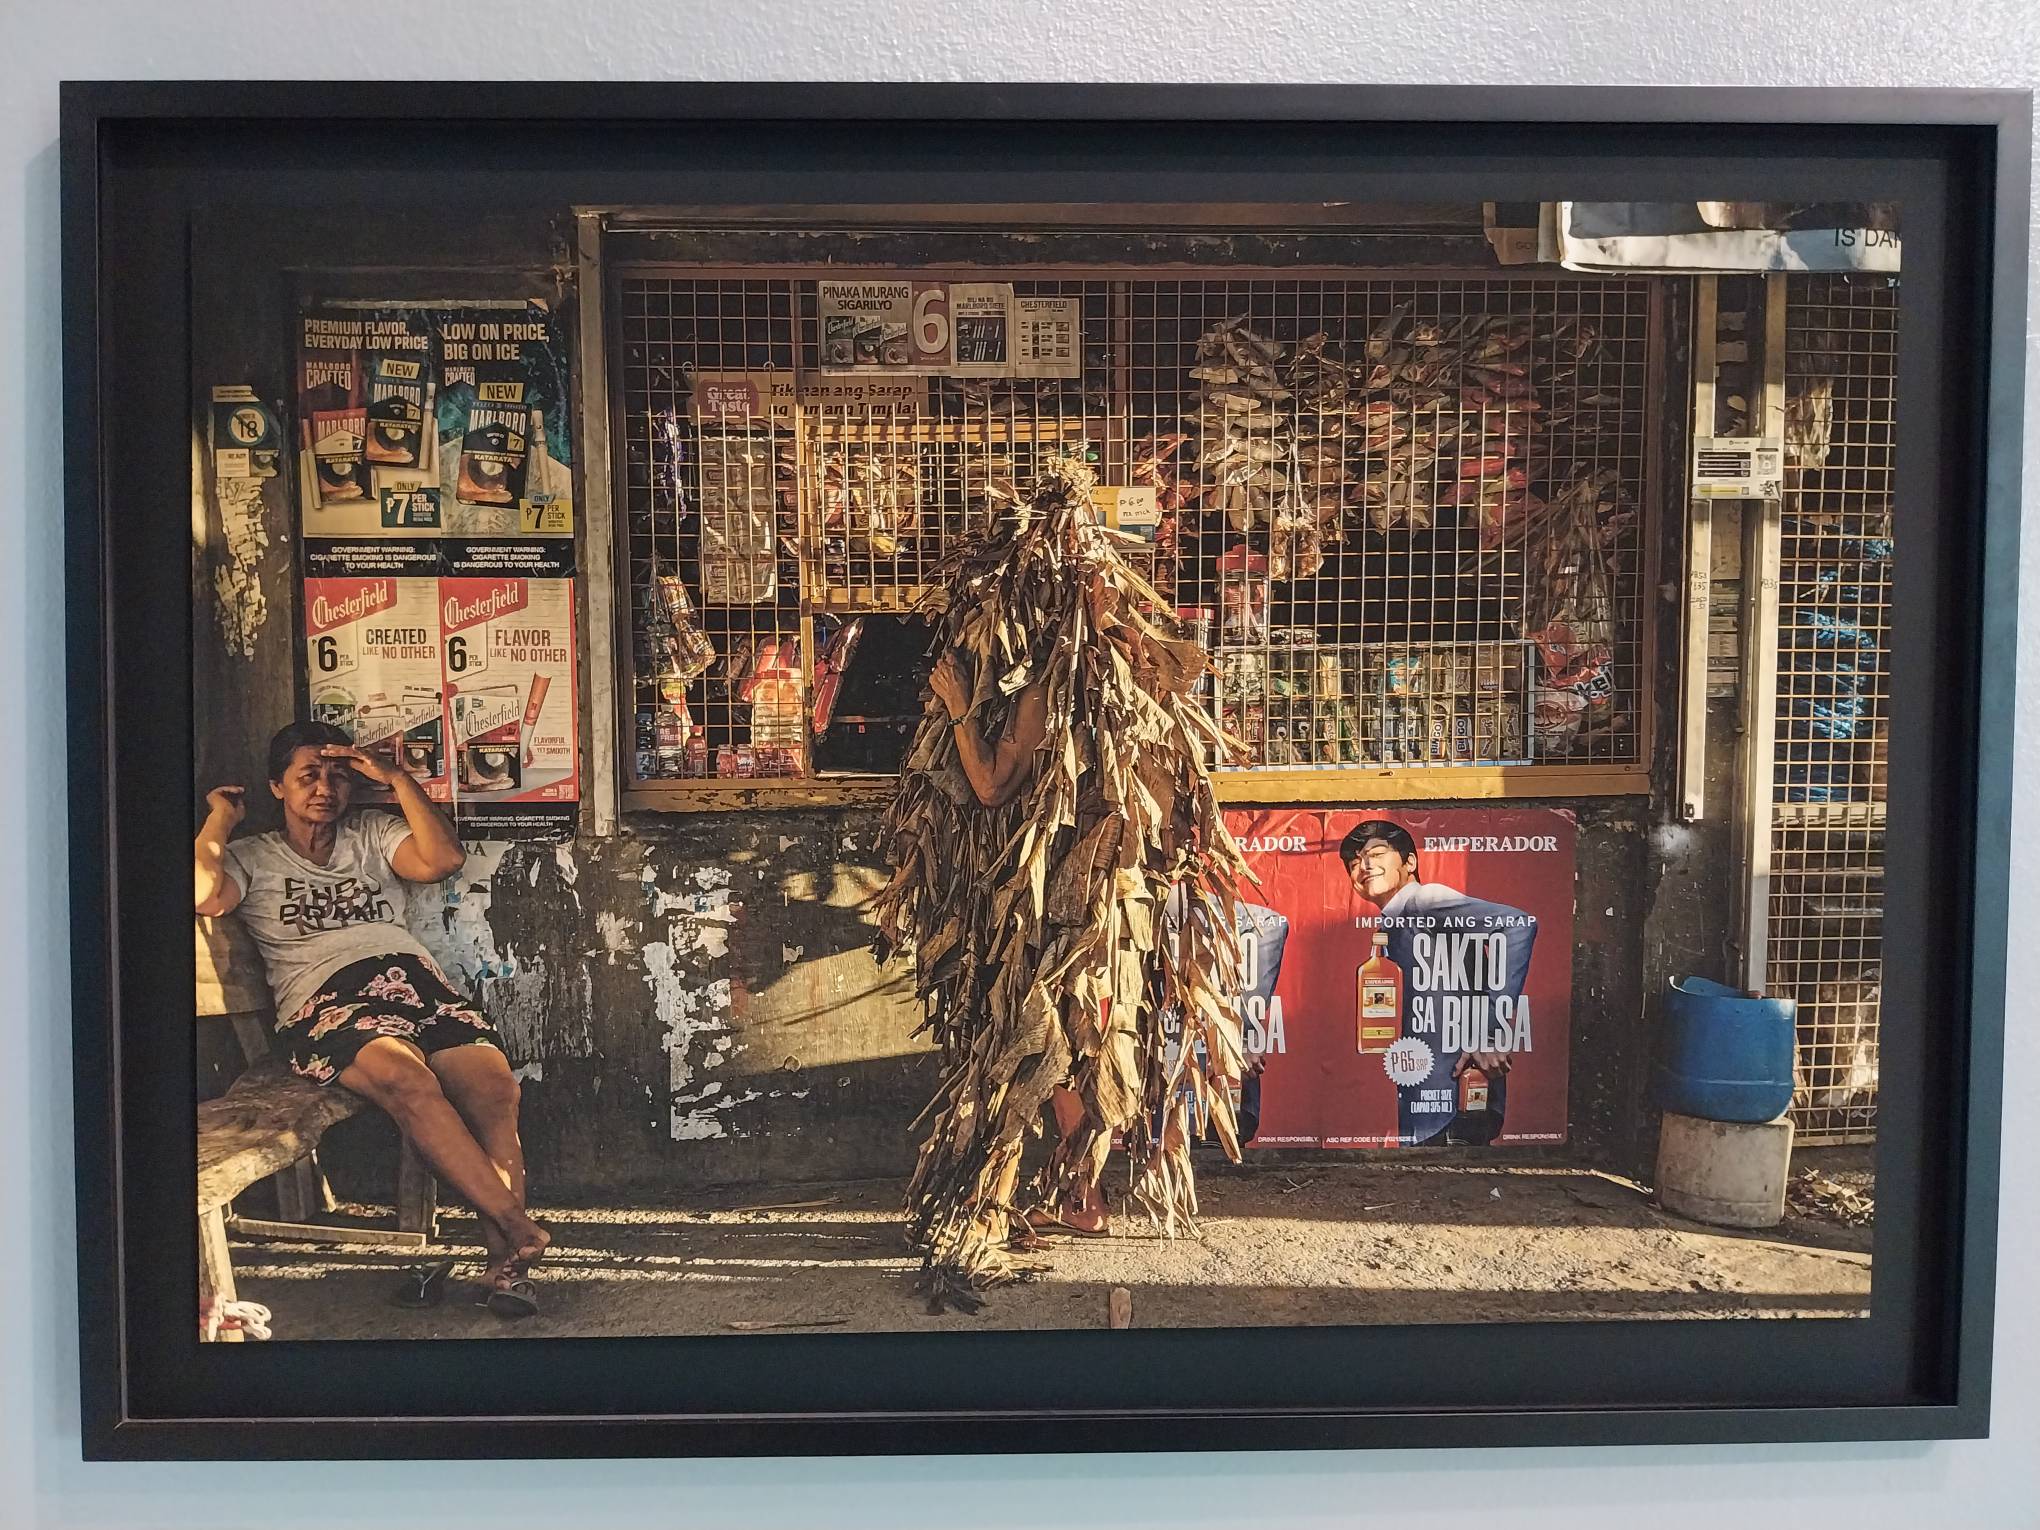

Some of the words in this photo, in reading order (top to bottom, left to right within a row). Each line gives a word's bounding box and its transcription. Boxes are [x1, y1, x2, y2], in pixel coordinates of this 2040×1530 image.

[1834, 227, 1856, 247] IS
[823, 286, 860, 298] PINAKA
[862, 286, 908, 298] MURANG
[837, 300, 893, 310] SIGARILYO
[305, 320, 362, 335] PREMIUM
[364, 321, 410, 336] FLAVOR,
[443, 323, 476, 340] LOW
[479, 323, 500, 340] ON
[503, 323, 549, 342] PRICE,
[305, 334, 363, 350] EVERYDAY
[366, 336, 392, 350] LOW
[394, 336, 429, 350] PRICE
[444, 343, 468, 360] BIG
[471, 343, 492, 360] ON
[496, 343, 520, 360] ICE
[306, 361, 351, 370] MARLBORO
[386, 363, 414, 377] NEW
[306, 369, 352, 391] CRAFTED
[444, 371, 476, 387] CRAFTED
[373, 383, 421, 406] MARLBORO
[486, 385, 517, 400] NEW
[706, 387, 750, 400] Great
[833, 386, 864, 400] ang
[868, 384, 913, 400] Sarap
[240, 420, 259, 438] 18
[317, 417, 366, 441] MARLBORO
[468, 409, 527, 436] MARLBORO
[396, 482, 415, 491] ONLY
[411, 493, 428, 503] PER
[411, 502, 435, 512] STICK
[547, 504, 560, 512] PER
[547, 512, 566, 520] STICK
[461, 561, 503, 569] DANGEROUS
[504, 561, 514, 569] TO
[515, 561, 533, 569] YOUR
[534, 561, 560, 569] HEALTH
[312, 580, 388, 629] Chesterfield
[444, 582, 519, 629] Chesterfield
[366, 629, 427, 645] CREATED
[495, 630, 551, 647] FLAVOR
[362, 647, 379, 656] LIKE
[382, 646, 397, 659] NO
[400, 646, 436, 659] OTHER
[489, 648, 507, 658] LIKE
[510, 649, 527, 662] NO
[530, 649, 567, 662] OTHER
[357, 719, 395, 743] hesterfield
[1457, 719, 1466, 751] BIGO
[1232, 836, 1307, 852] RADOR
[1424, 836, 1558, 852] EMPERADOR
[1235, 916, 1287, 928] SARAP
[1355, 916, 1437, 928] IMPORTED
[1443, 916, 1477, 928] ANG
[1484, 915, 1537, 928] SARAP
[1412, 933, 1507, 992] SAKTO
[1411, 996, 1436, 1034] SA
[1441, 994, 1533, 1053] BULSA
[1420, 1089, 1440, 1101] POCKET
